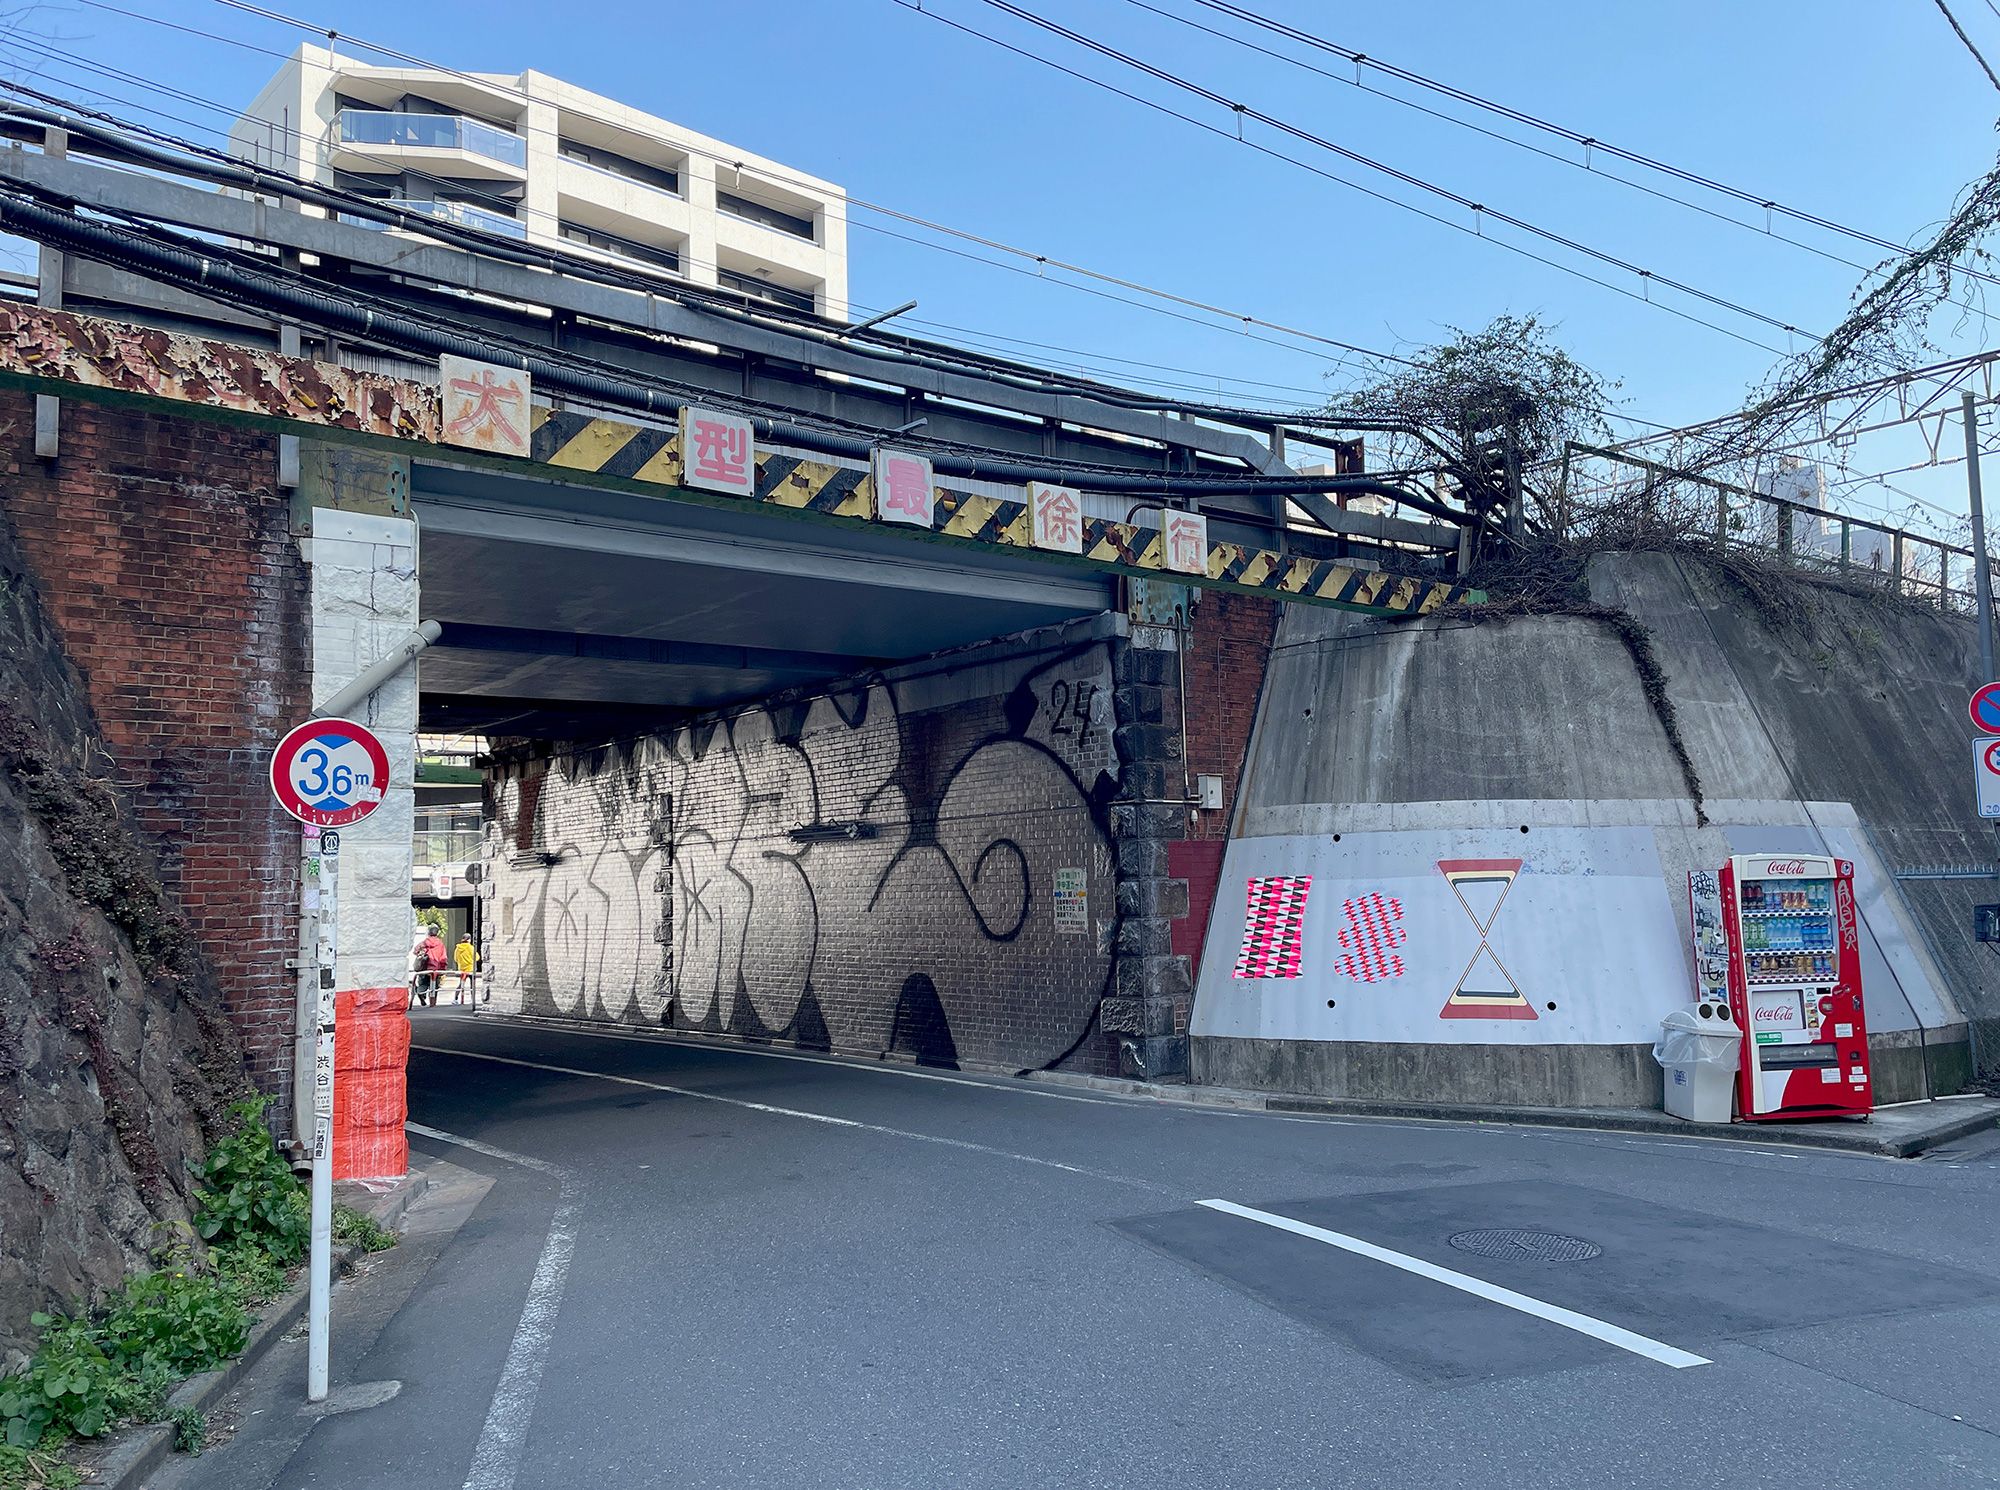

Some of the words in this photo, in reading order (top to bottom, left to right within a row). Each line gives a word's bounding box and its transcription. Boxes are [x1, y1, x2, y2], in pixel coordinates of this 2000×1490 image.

[447, 369, 524, 448] 大
[694, 420, 748, 485] 型
[885, 458, 929, 519] 最
[1037, 489, 1079, 544] 徐
[1170, 517, 1204, 569] 行
[316, 1055, 330, 1086] 渋谷
